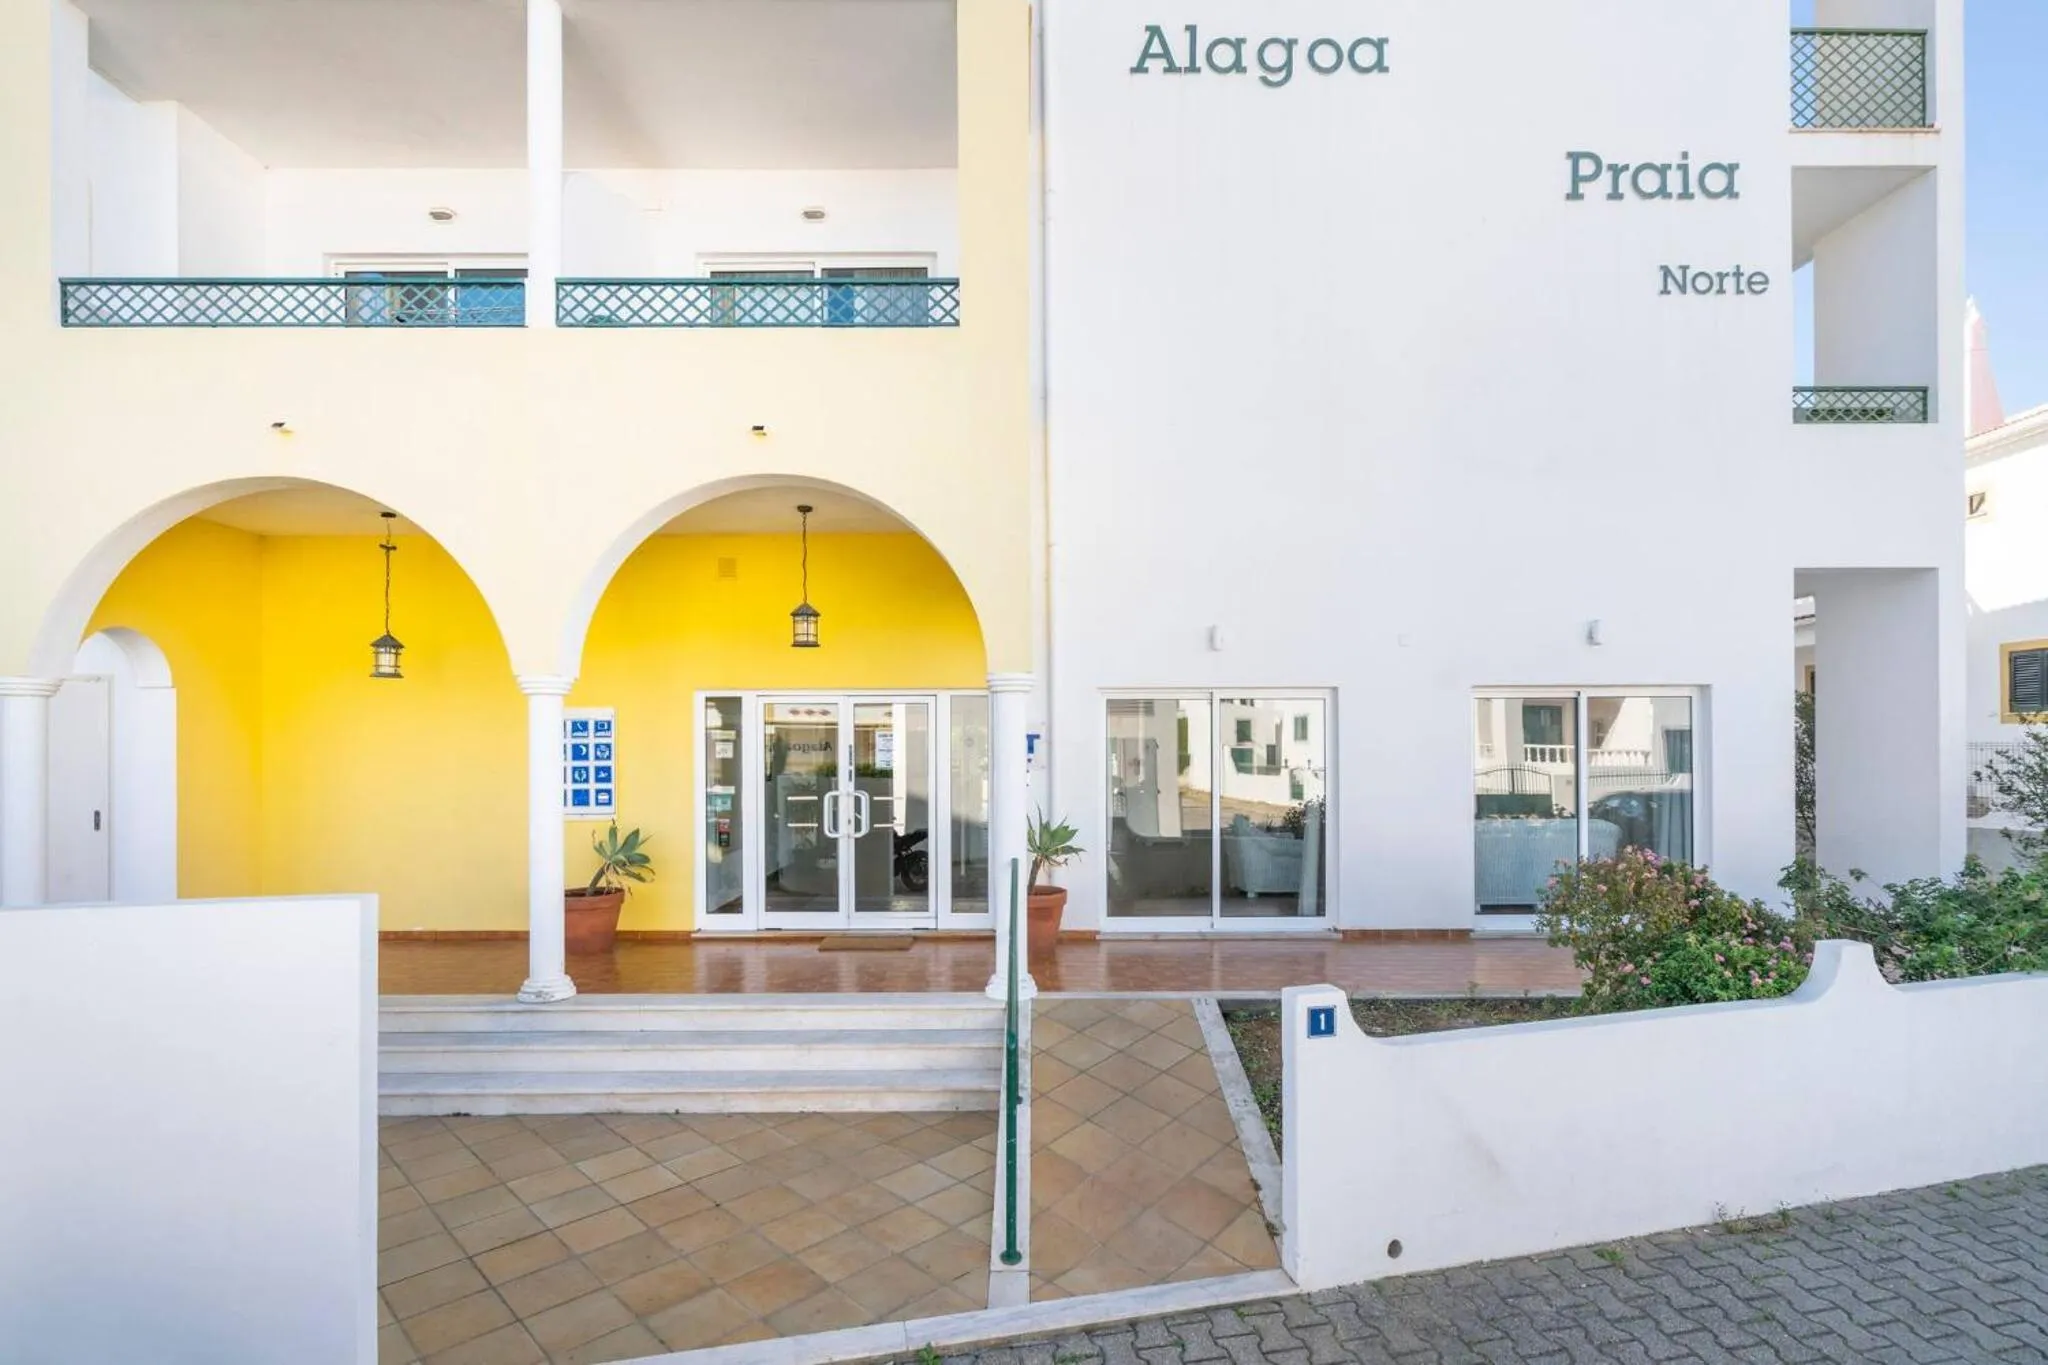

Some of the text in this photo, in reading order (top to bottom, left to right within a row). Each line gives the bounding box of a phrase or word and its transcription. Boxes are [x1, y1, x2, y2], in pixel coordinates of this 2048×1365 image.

[1130, 25, 1389, 87] Alagoa
[1566, 151, 1740, 200] Praia
[1660, 265, 1769, 295] Norte
[1319, 1012, 1326, 1031] 1
